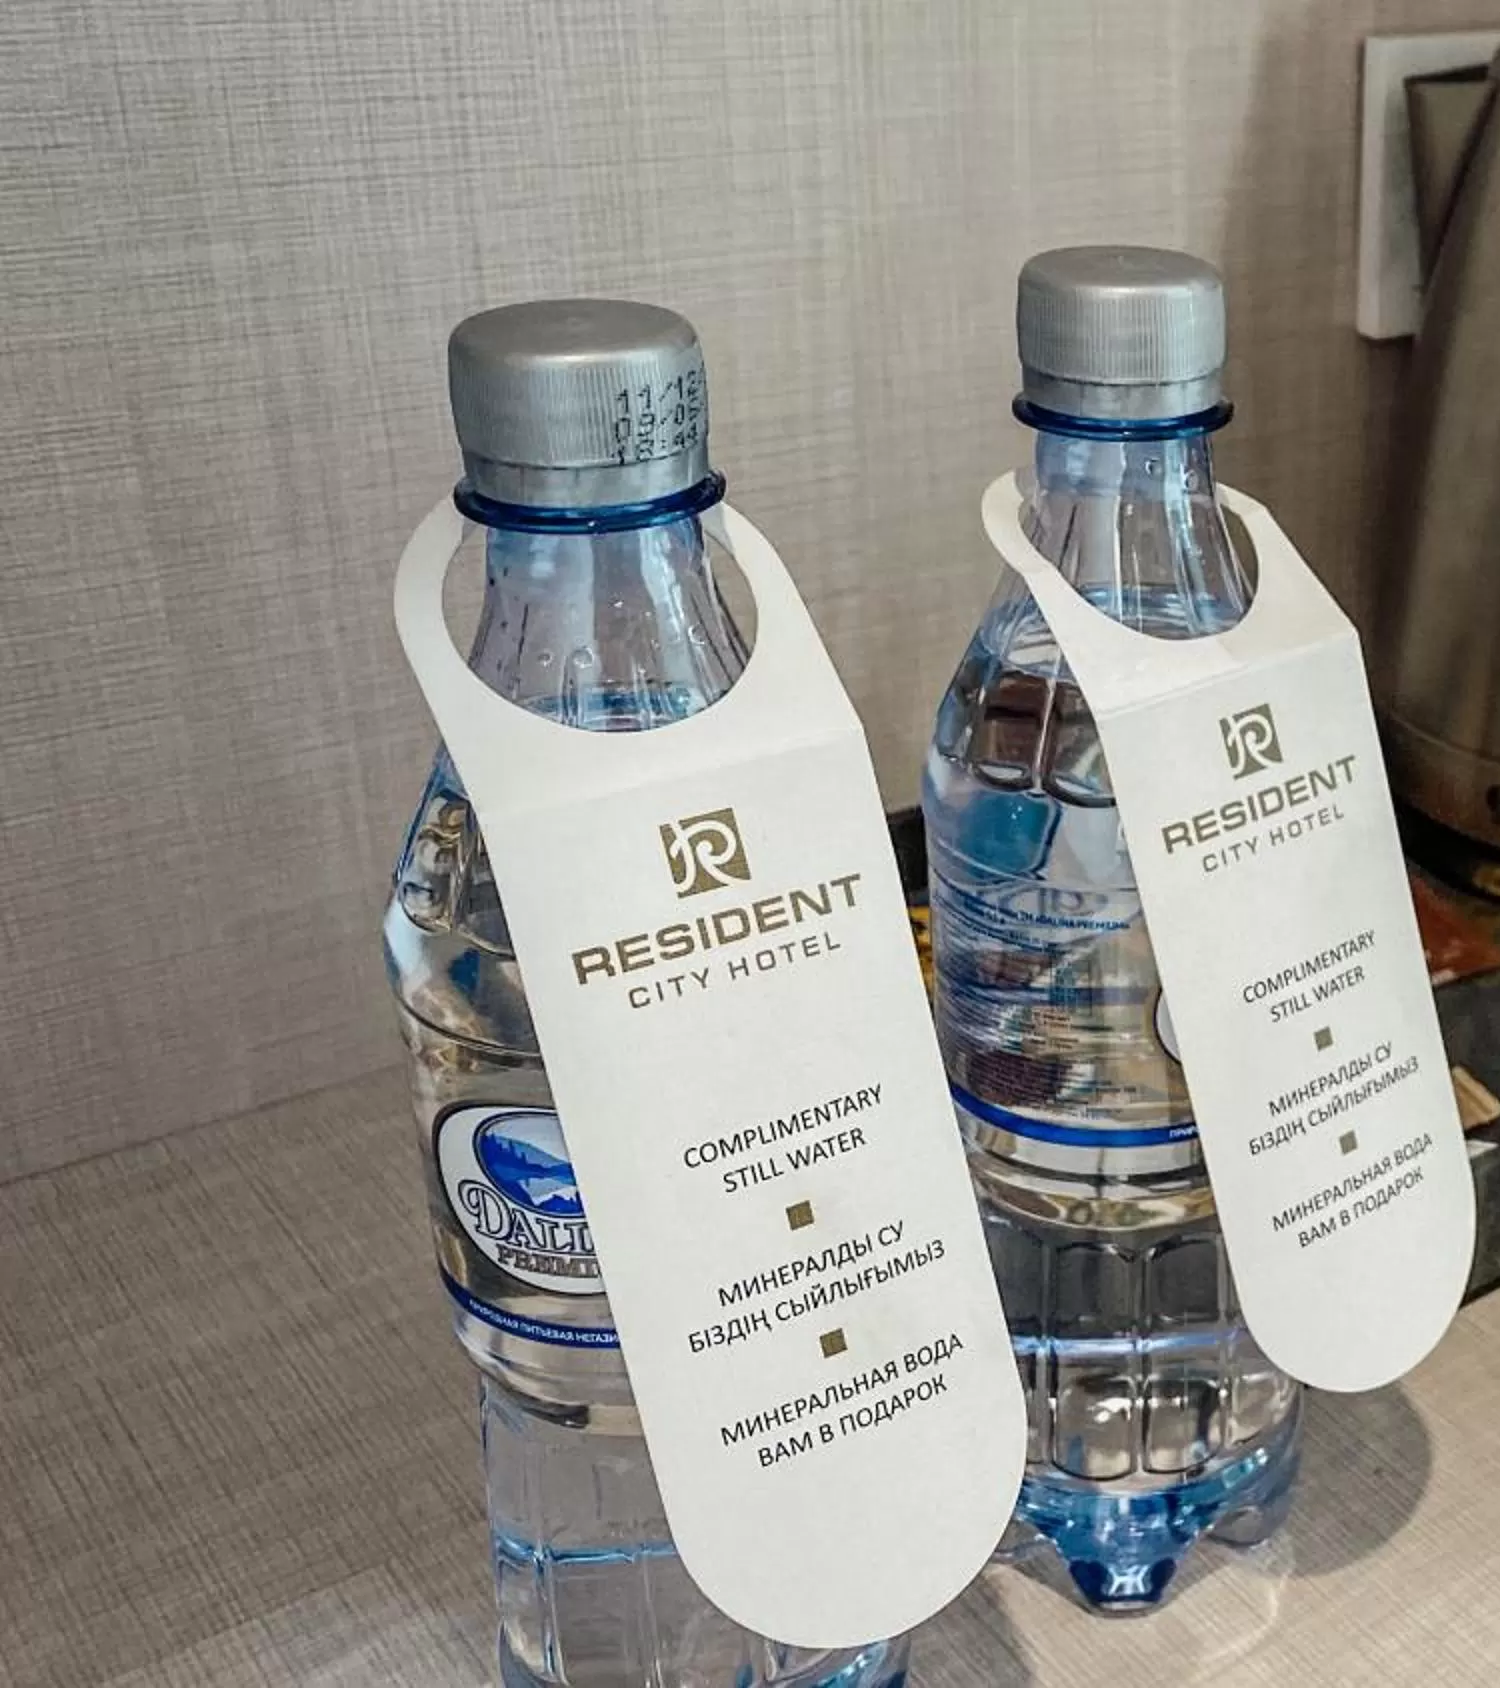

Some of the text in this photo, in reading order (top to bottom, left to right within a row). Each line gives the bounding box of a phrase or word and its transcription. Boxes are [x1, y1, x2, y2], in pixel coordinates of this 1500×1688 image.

[1161, 755, 1356, 854] RESIDENT
[1202, 804, 1344, 873] CITY HOTEL
[572, 873, 861, 985] RESIDENT
[1243, 930, 1375, 1003] COMPLIMENTARY
[628, 932, 841, 1009] CITY HOTEL
[1270, 965, 1365, 1023] STILL WATER
[1268, 1041, 1393, 1117] МИНЕРАЛДЫ СУ
[684, 1084, 882, 1168] COMPLIMENTARY
[723, 1127, 867, 1193] STILL WATER
[1249, 1118, 1307, 1156] БІЗДІҢ
[458, 1179, 597, 1257] DALI
[1272, 1132, 1433, 1232] МИНЕРАЛЬНАЯ ВОДА
[1298, 1166, 1424, 1248] ВАМ В ПОДАРОК
[496, 1243, 600, 1279] PREMI
[688, 1239, 945, 1353] БІЗДІҢ СЫЙЛЫҒЫМЫЗ
[718, 1220, 904, 1307] МИНЕРАЛДЫ СУ
[576, 1331, 619, 1343] НЕГАЗИ
[721, 1333, 964, 1446] МИНЕРАЛЬНАЯ ВОДА
[758, 1374, 948, 1467] ВАМ В ПОДАРОК
